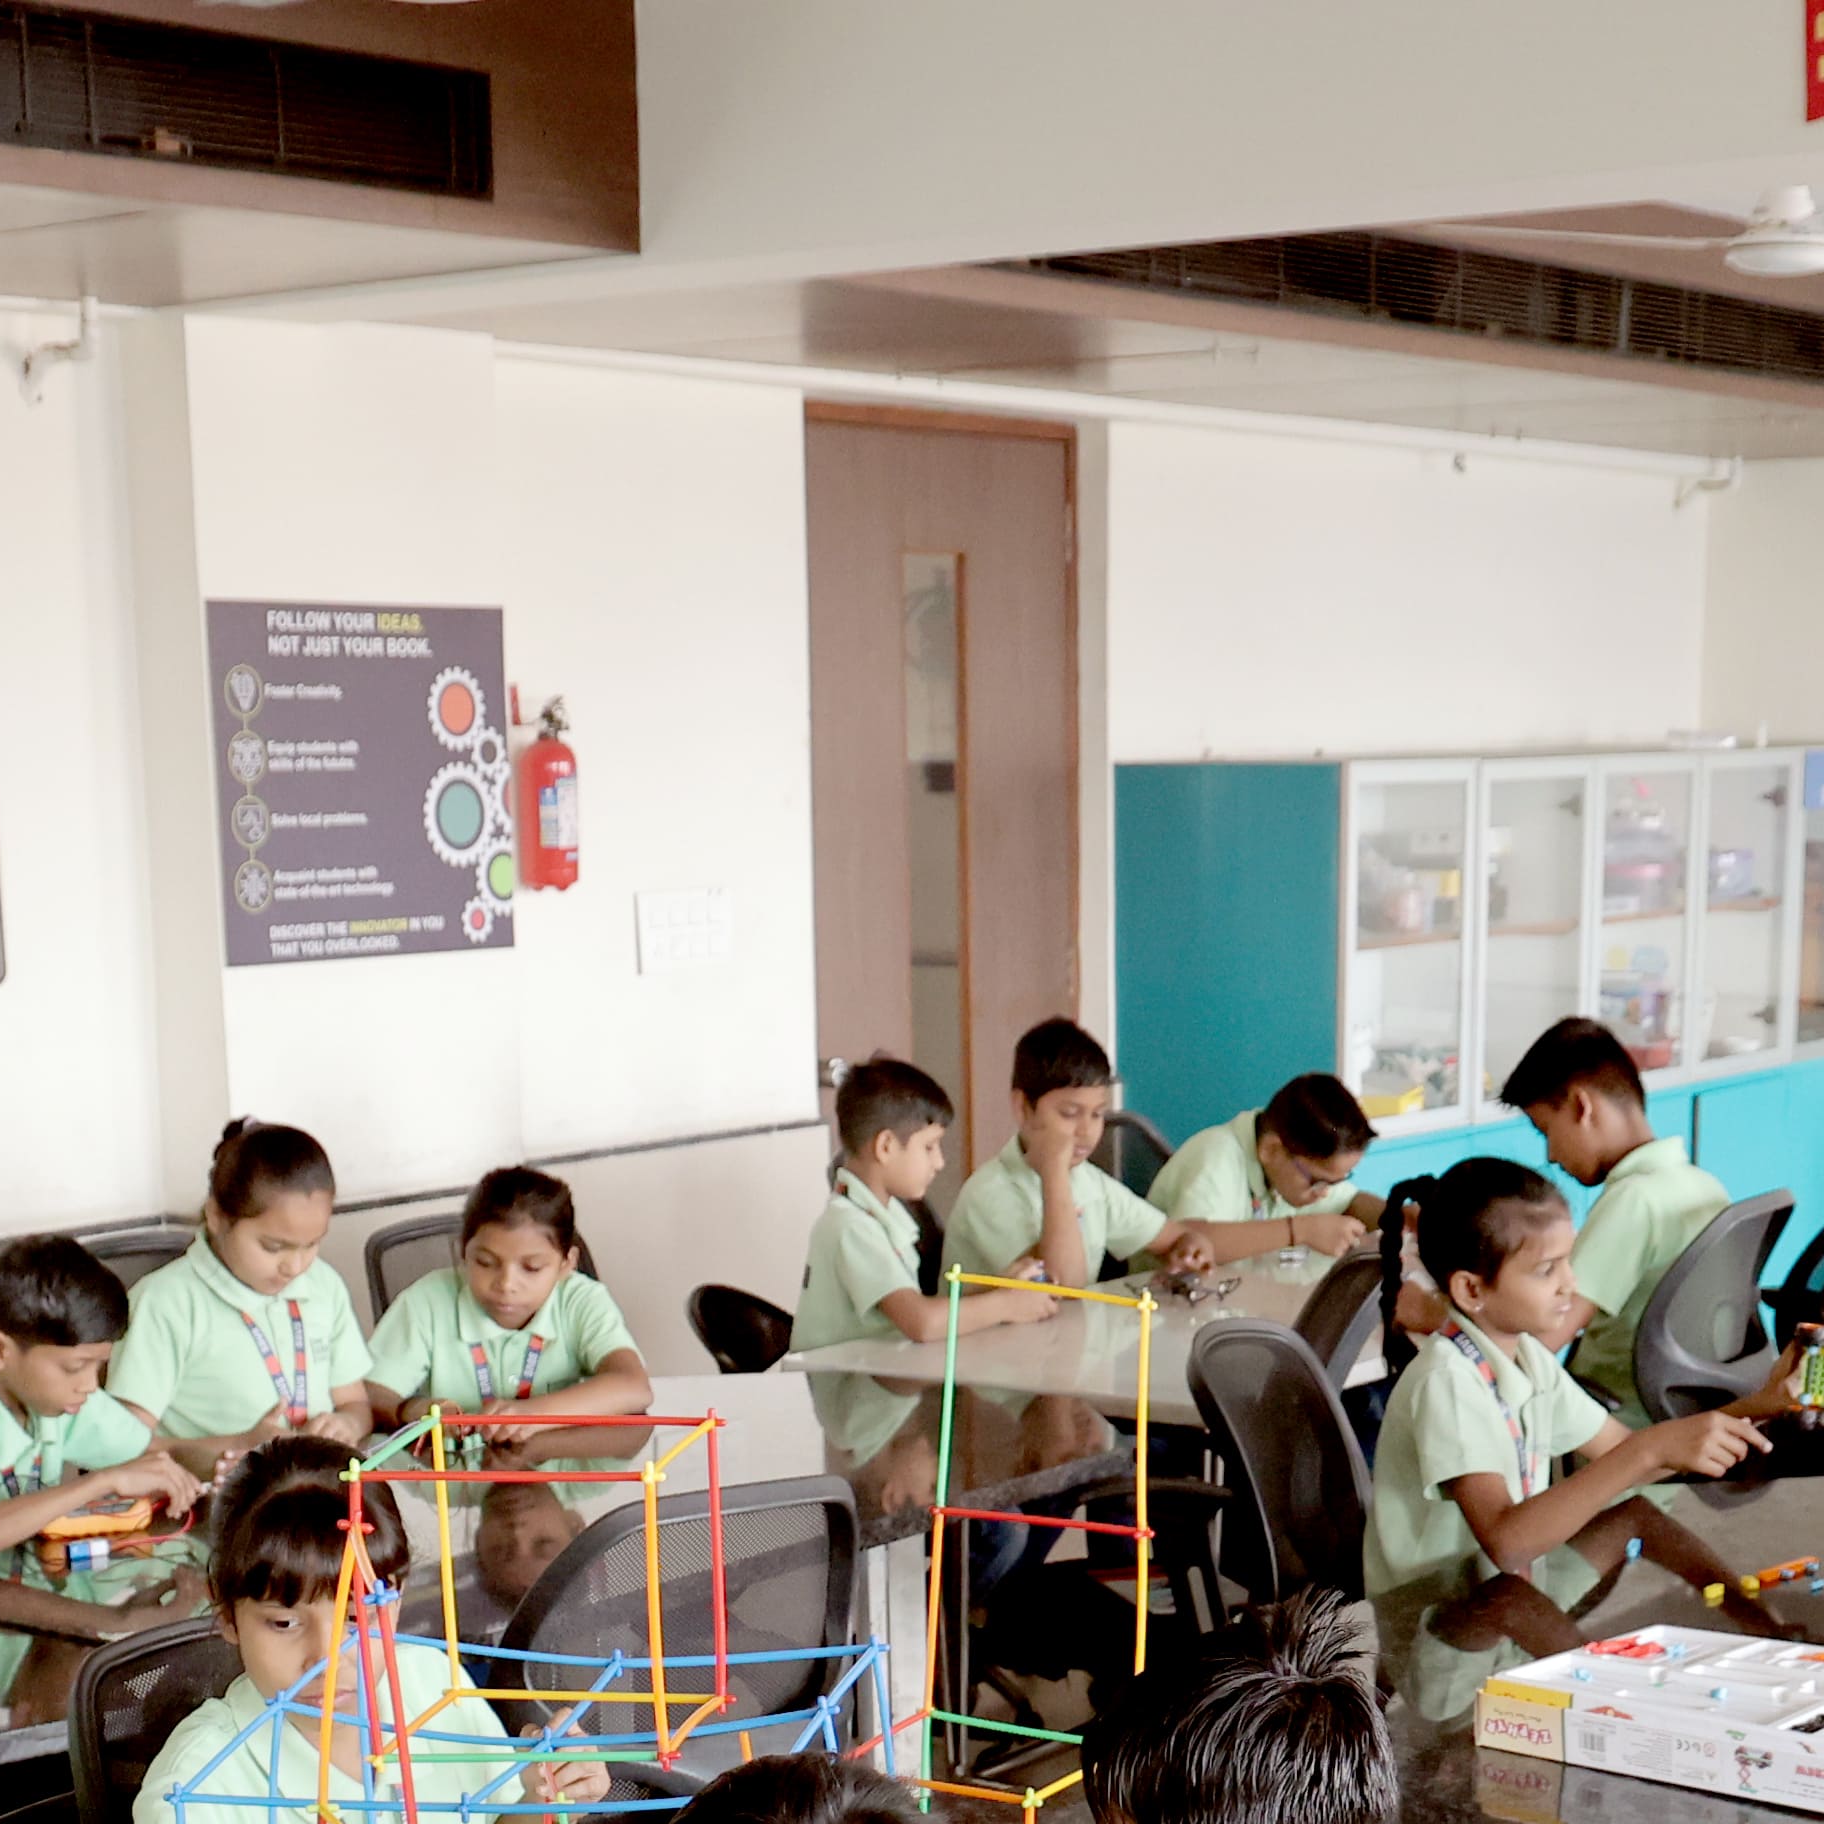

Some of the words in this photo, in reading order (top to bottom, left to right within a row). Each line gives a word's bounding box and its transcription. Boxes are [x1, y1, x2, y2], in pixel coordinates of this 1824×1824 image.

[266, 610, 332, 633] FOLLOW
[333, 612, 376, 633] YOUR
[267, 635, 300, 656] NOT
[302, 636, 341, 657] JUST
[342, 636, 385, 657] YOUR
[386, 637, 433, 658] BOOK.
[269, 921, 326, 941] DISCOVER
[327, 920, 348, 937] THE
[271, 941, 299, 958] THAT
[300, 939, 324, 956] YOU
[1484, 1717, 1553, 1745] ZEPHYR
